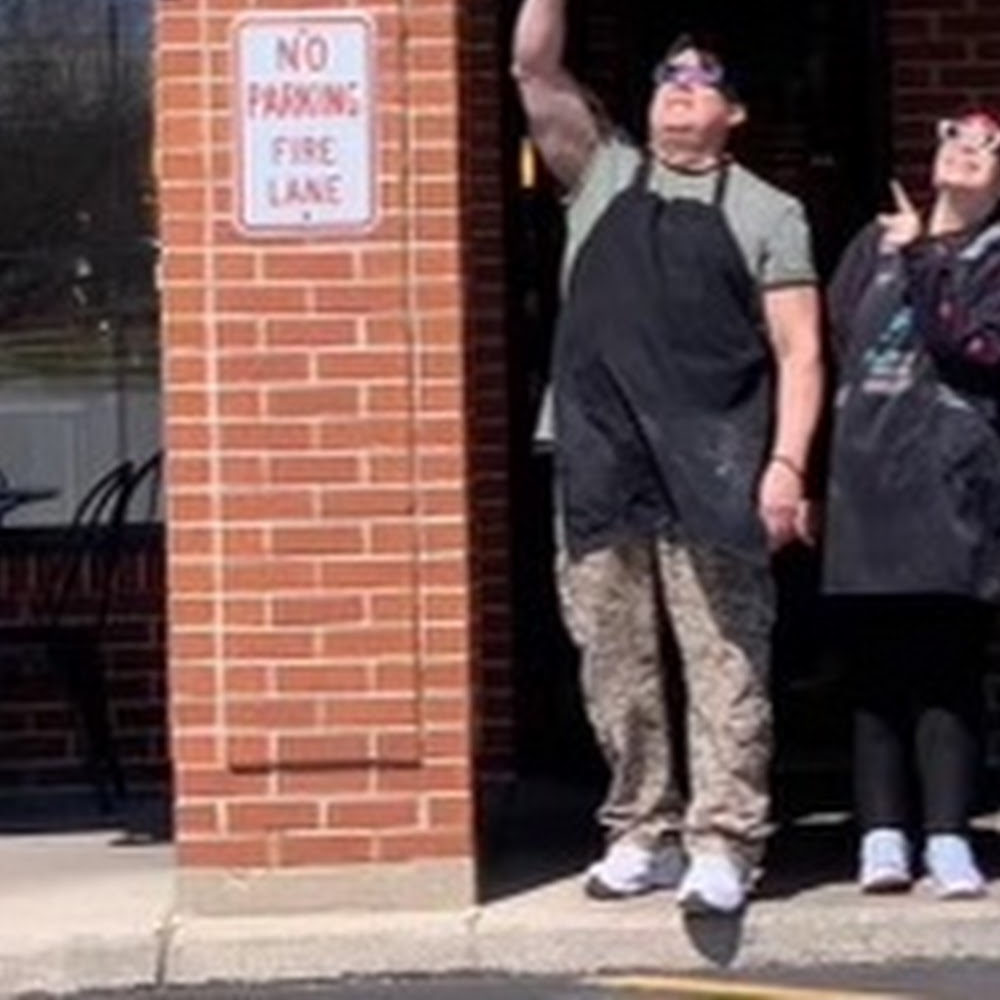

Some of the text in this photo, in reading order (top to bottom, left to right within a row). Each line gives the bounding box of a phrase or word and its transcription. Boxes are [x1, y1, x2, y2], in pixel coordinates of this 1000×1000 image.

[275, 36, 329, 73] NO
[249, 82, 359, 118] PARKING
[272, 136, 337, 166] FIRE
[267, 175, 343, 207] LANE
